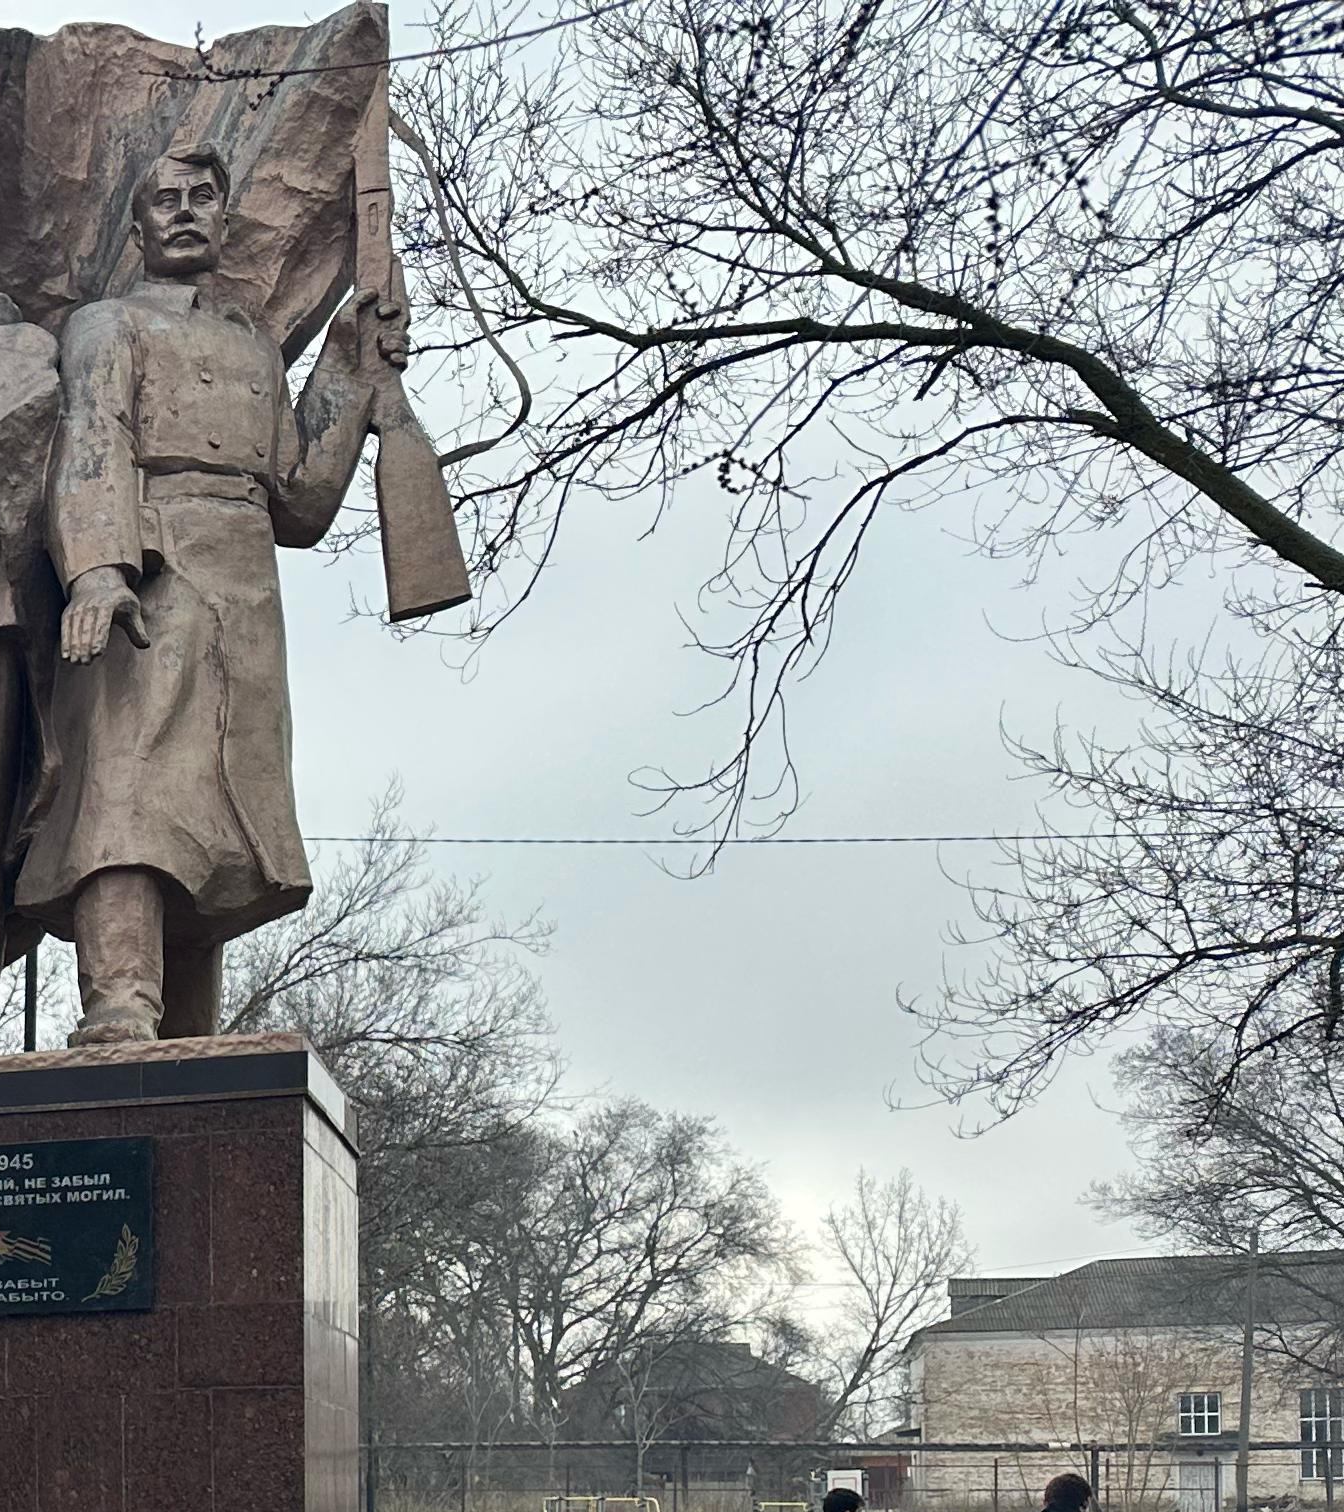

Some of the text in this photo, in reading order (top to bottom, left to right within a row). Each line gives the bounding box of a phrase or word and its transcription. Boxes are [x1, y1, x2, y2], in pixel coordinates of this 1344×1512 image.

[24, 1177, 46, 1189] НЕ
[51, 1174, 110, 1188] ЗАБЫЛ
[67, 1189, 130, 1203] МОГИЛ.
